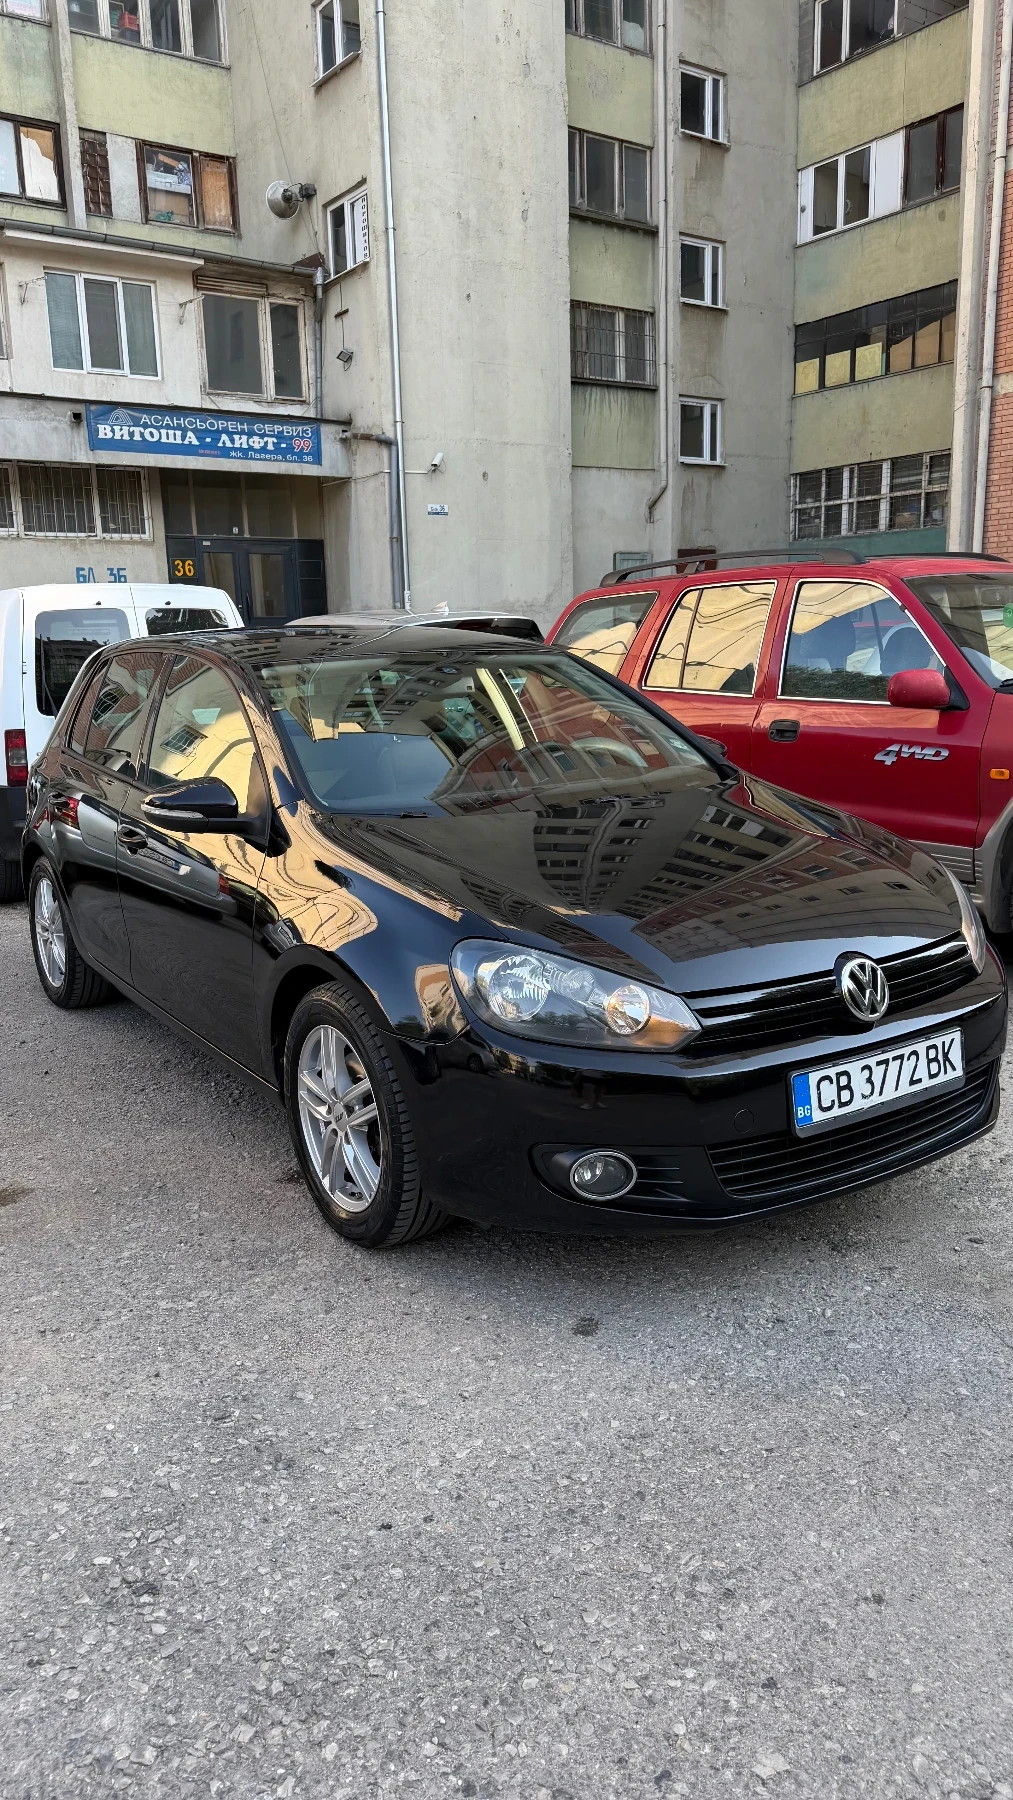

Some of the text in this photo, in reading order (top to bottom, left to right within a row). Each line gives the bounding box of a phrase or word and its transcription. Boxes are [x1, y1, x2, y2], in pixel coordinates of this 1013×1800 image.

[139, 414, 312, 438] АСАНСЬОРЕН СЕРВИЗ
[97, 424, 199, 446] ВИТОША
[217, 435, 277, 451] ЛИФТ
[292, 438, 312, 453] 99
[107, 567, 128, 584] 36
[174, 559, 195, 577] 36
[873, 743, 950, 766] 4WD
[816, 1037, 957, 1113] CB 3772 BK
[797, 1105, 811, 1118] BG
